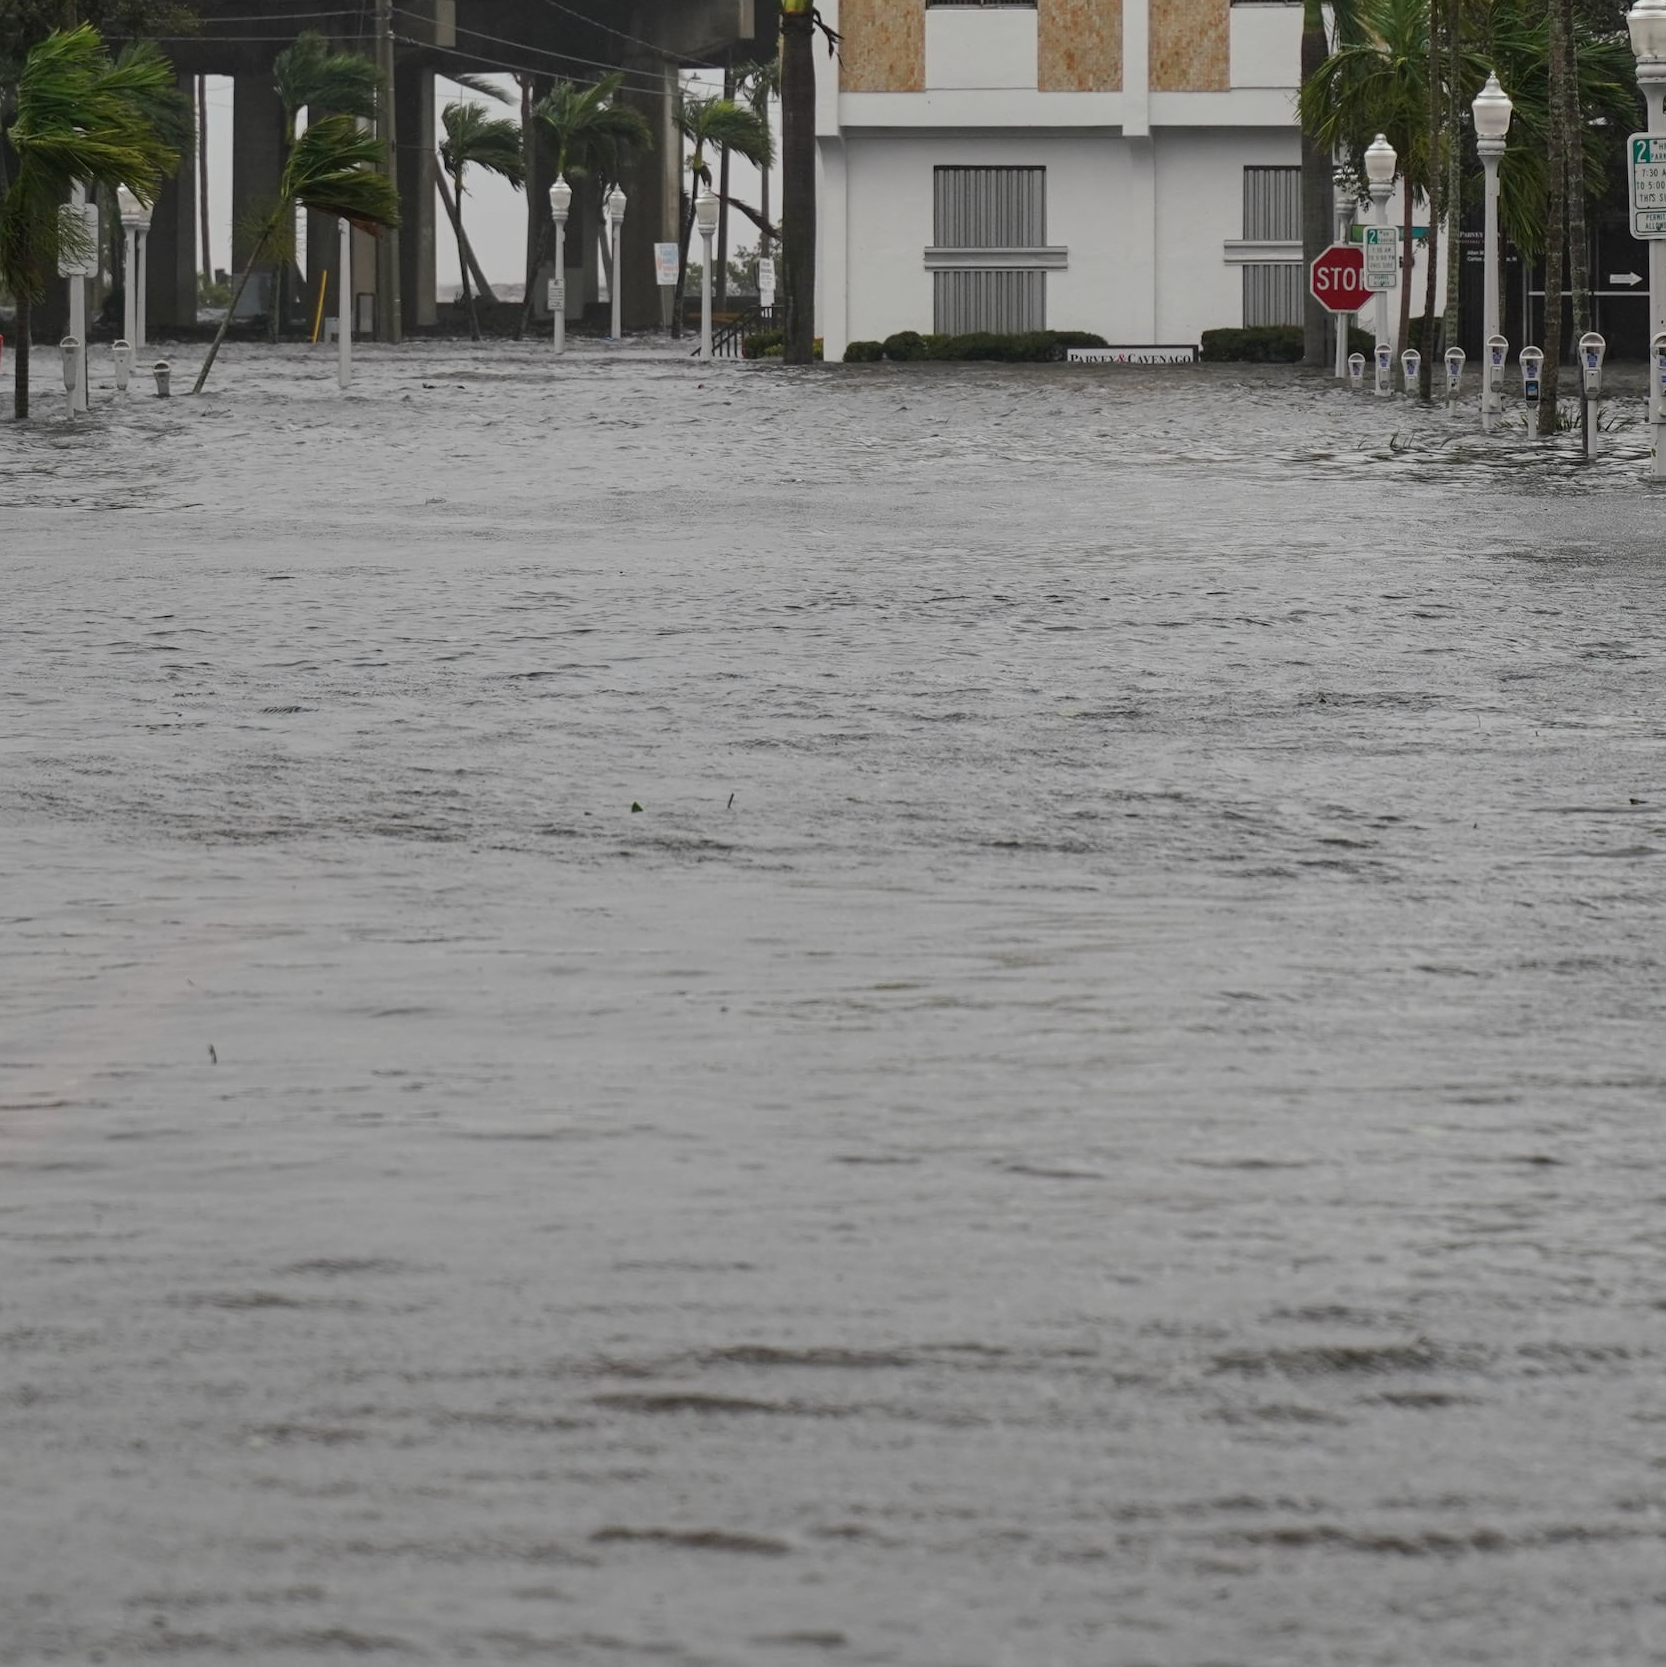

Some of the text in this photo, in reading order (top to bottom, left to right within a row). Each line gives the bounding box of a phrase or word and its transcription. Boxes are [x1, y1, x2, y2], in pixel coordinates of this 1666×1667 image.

[1636, 140, 1647, 163] 2
[1642, 168, 1659, 178] 7:30
[1636, 181, 1645, 190] TO
[1648, 180, 1666, 190] 5:00
[1640, 193, 1656, 203] THIS
[1369, 229, 1376, 244] 2
